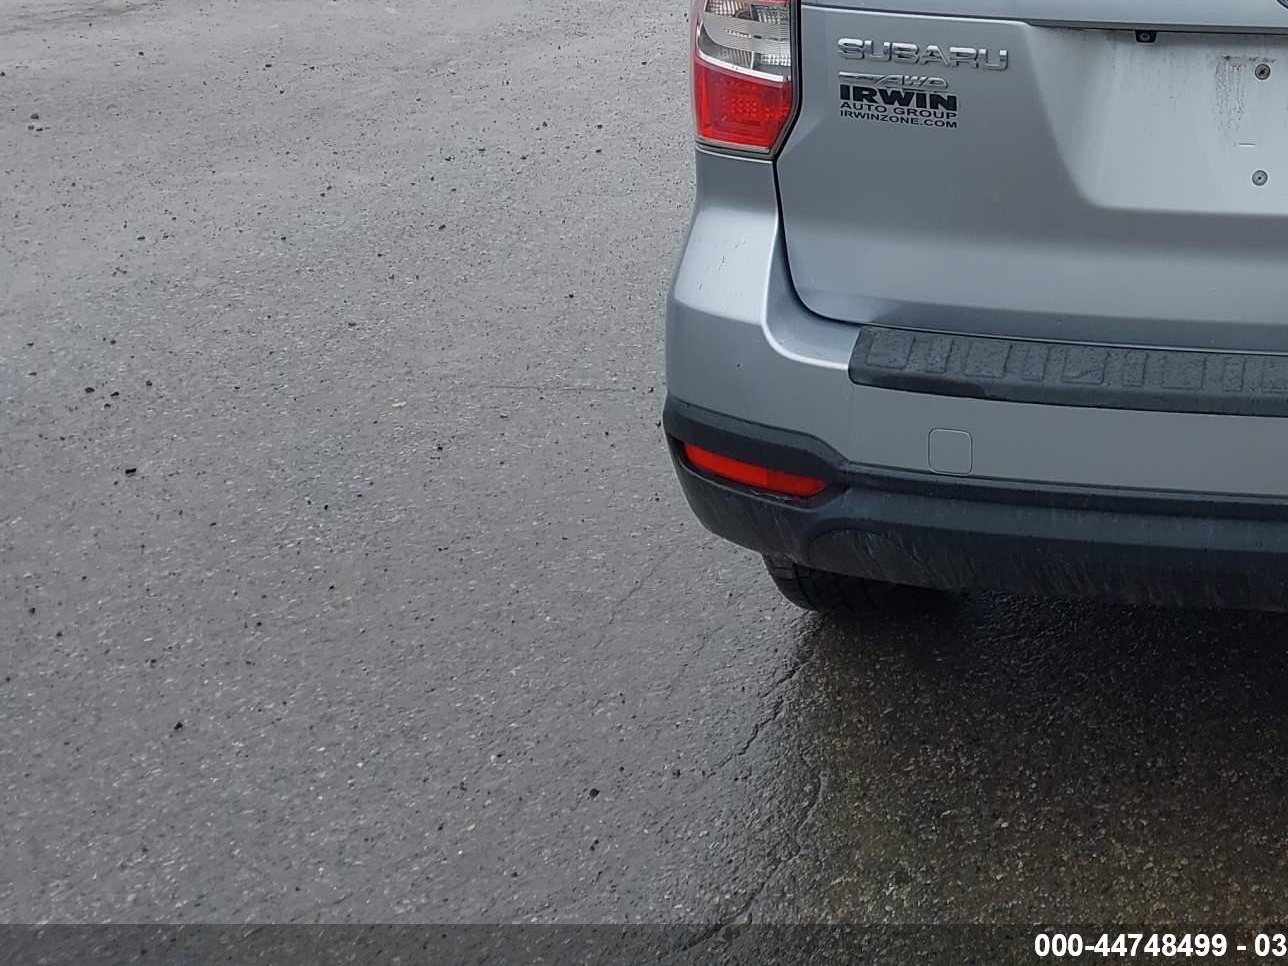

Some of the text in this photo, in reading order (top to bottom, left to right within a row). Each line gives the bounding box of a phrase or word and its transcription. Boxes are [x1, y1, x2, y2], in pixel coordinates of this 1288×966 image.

[837, 37, 1009, 72] SUBARU
[839, 84, 958, 112] IRWIN
[840, 101, 958, 120] AUTO GROUP
[840, 109, 958, 129] IRWINZONE.COM
